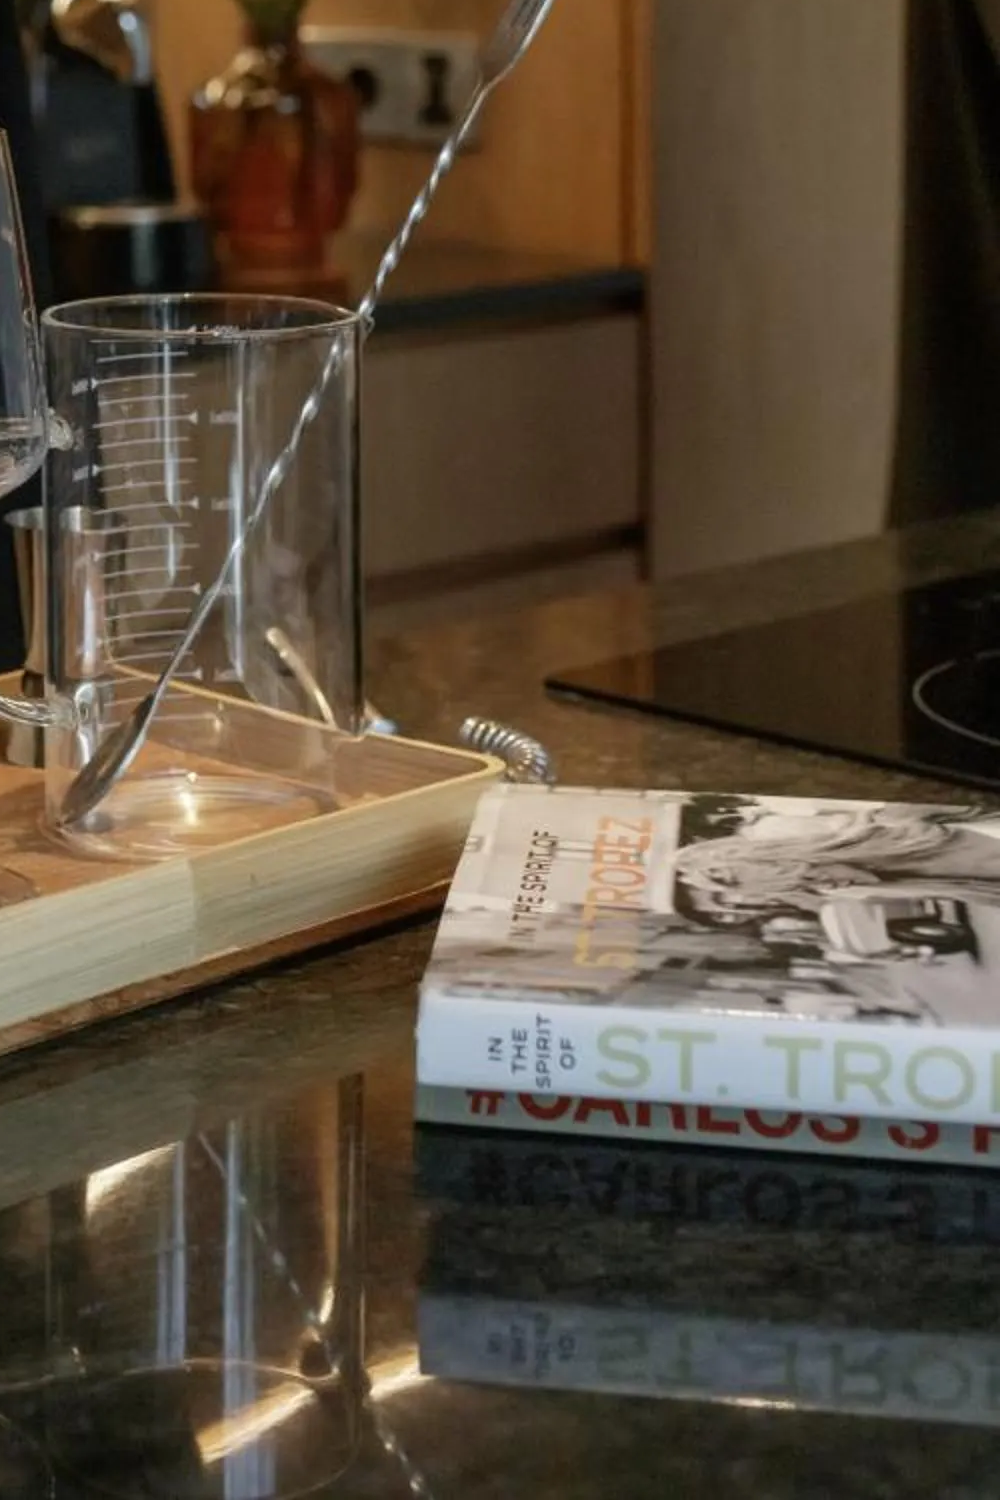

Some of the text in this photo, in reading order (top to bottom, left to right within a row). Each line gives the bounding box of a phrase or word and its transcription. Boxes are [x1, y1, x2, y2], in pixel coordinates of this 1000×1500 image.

[532, 830, 558, 850] OF
[520, 851, 555, 892] SPIRIT
[512, 894, 544, 922] THE
[488, 1037, 503, 1062] IN
[511, 1028, 528, 1074] THE
[535, 1013, 552, 1088] SPIRIT
[560, 1037, 577, 1071] OF
[595, 1025, 1000, 1113] ST. TRO
